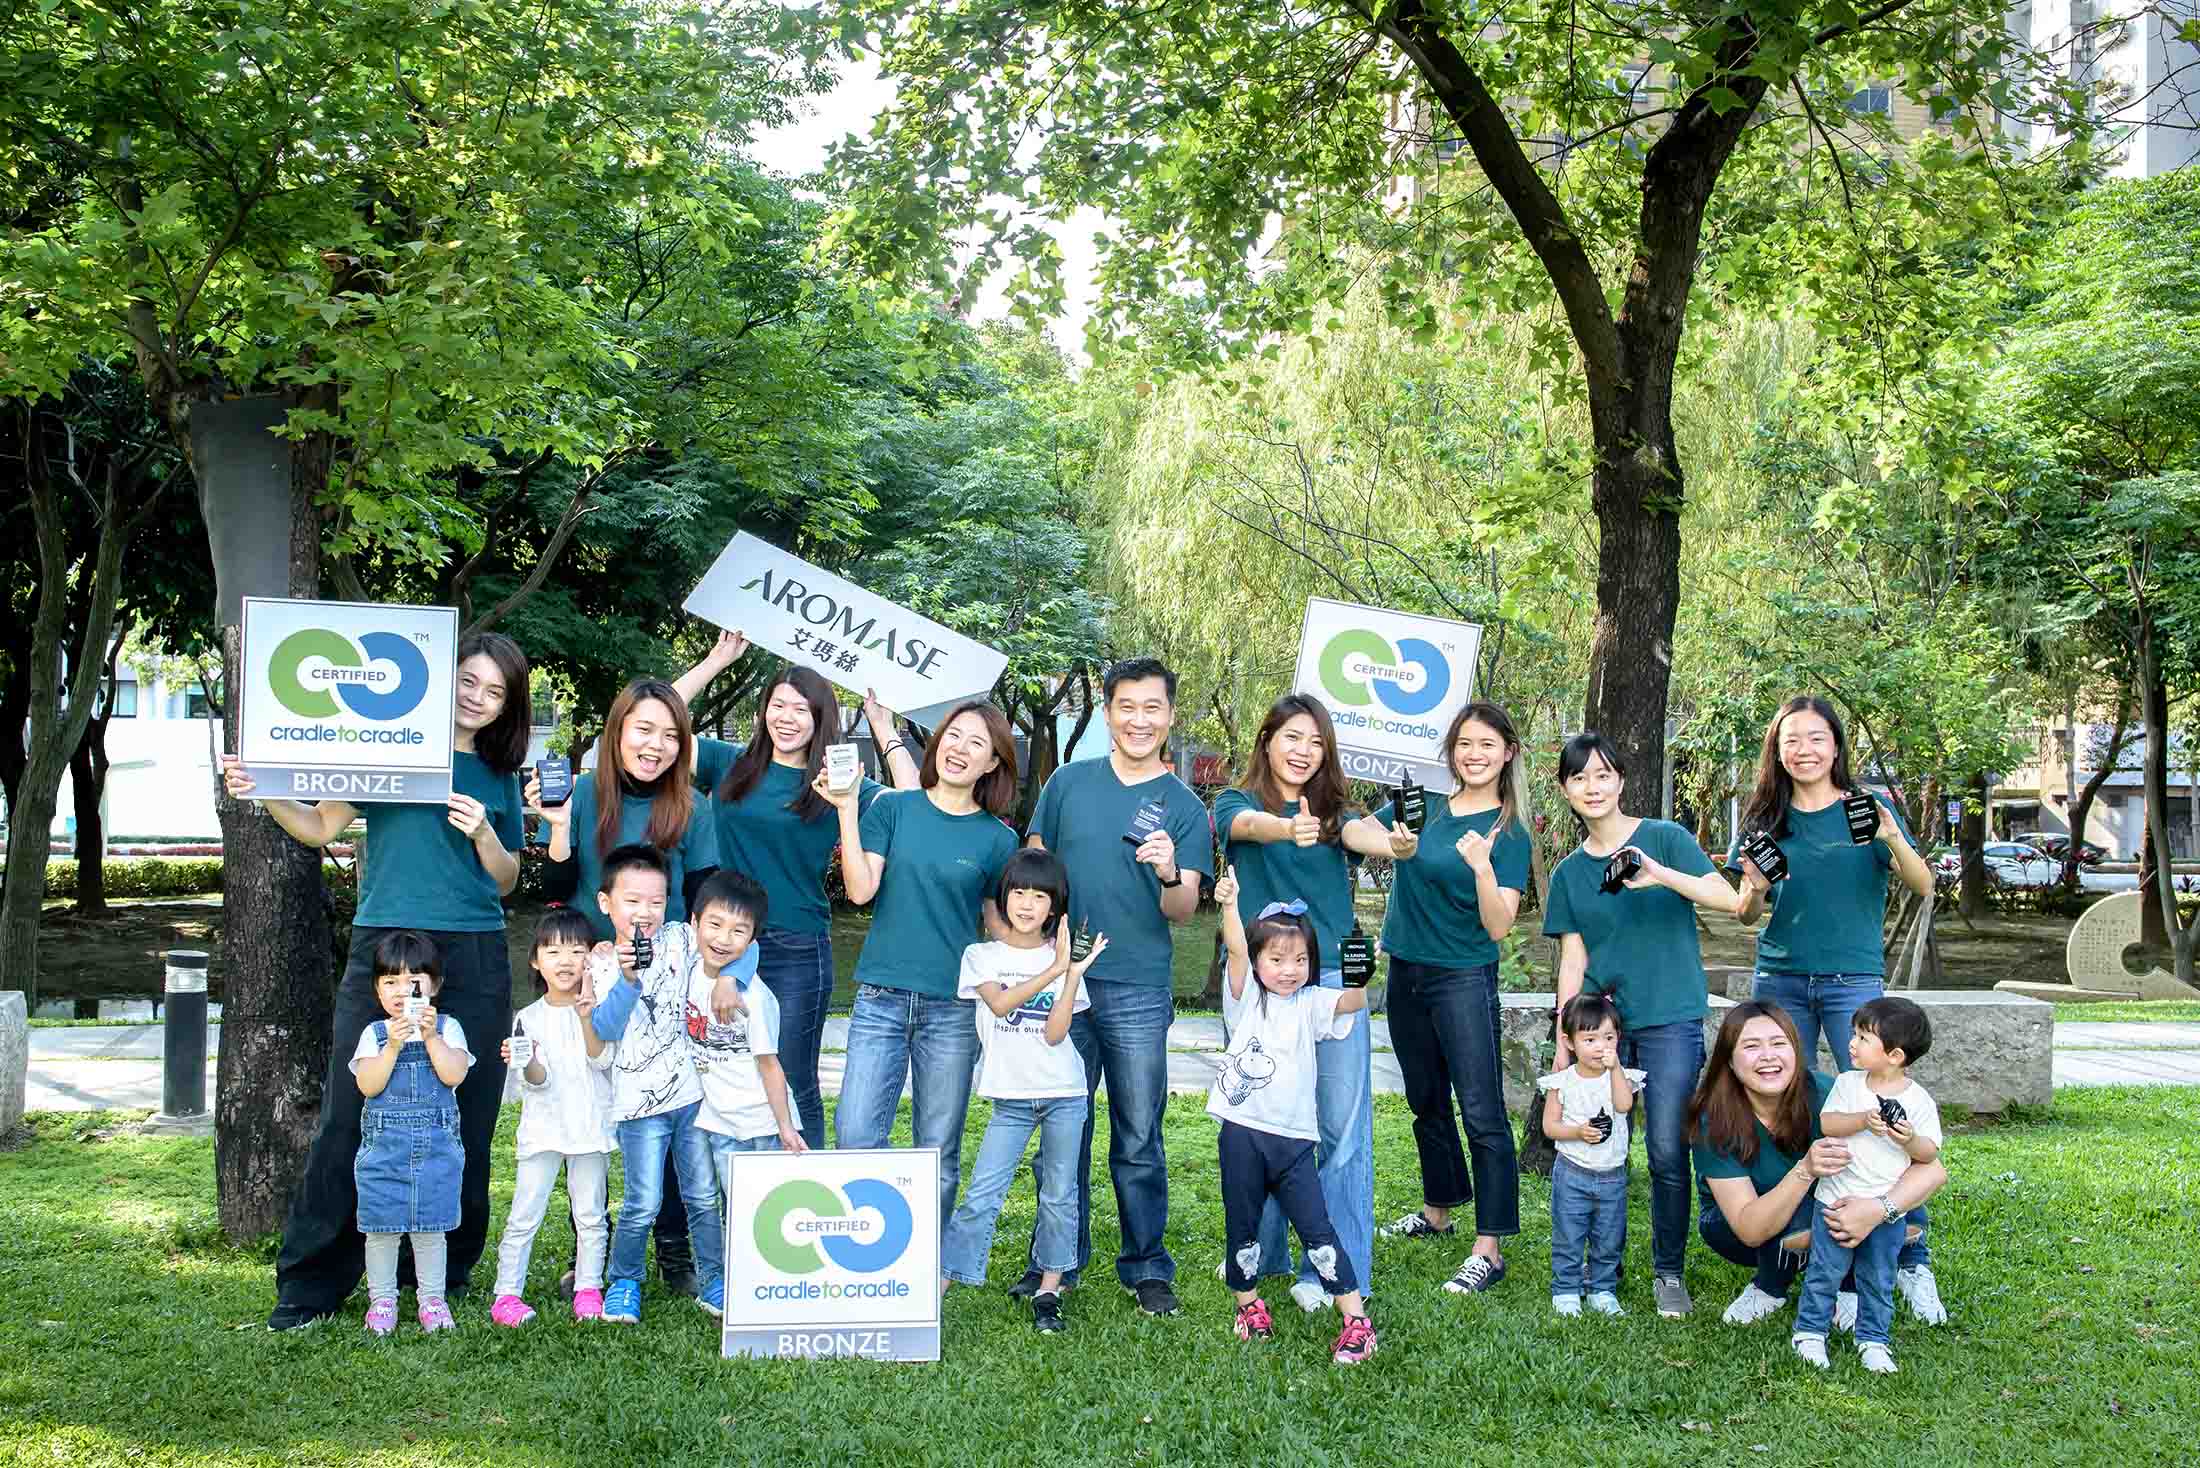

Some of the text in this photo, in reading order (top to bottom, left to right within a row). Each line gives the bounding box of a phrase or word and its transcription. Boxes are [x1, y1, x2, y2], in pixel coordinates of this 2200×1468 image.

[739, 568, 949, 680] AROMASE
[414, 632, 431, 642] TM
[786, 627, 860, 673] 艾瑪絲
[311, 668, 387, 682] CERTIFIED
[1352, 663, 1415, 681] CERTIFIED
[1328, 710, 1439, 740] adletocradle
[1339, 752, 1417, 782] RONZE
[293, 771, 404, 794] BRONZE
[896, 1176, 912, 1186] TM
[795, 1220, 870, 1232] CERTIFIED
[778, 1332, 891, 1354] BRONZE
